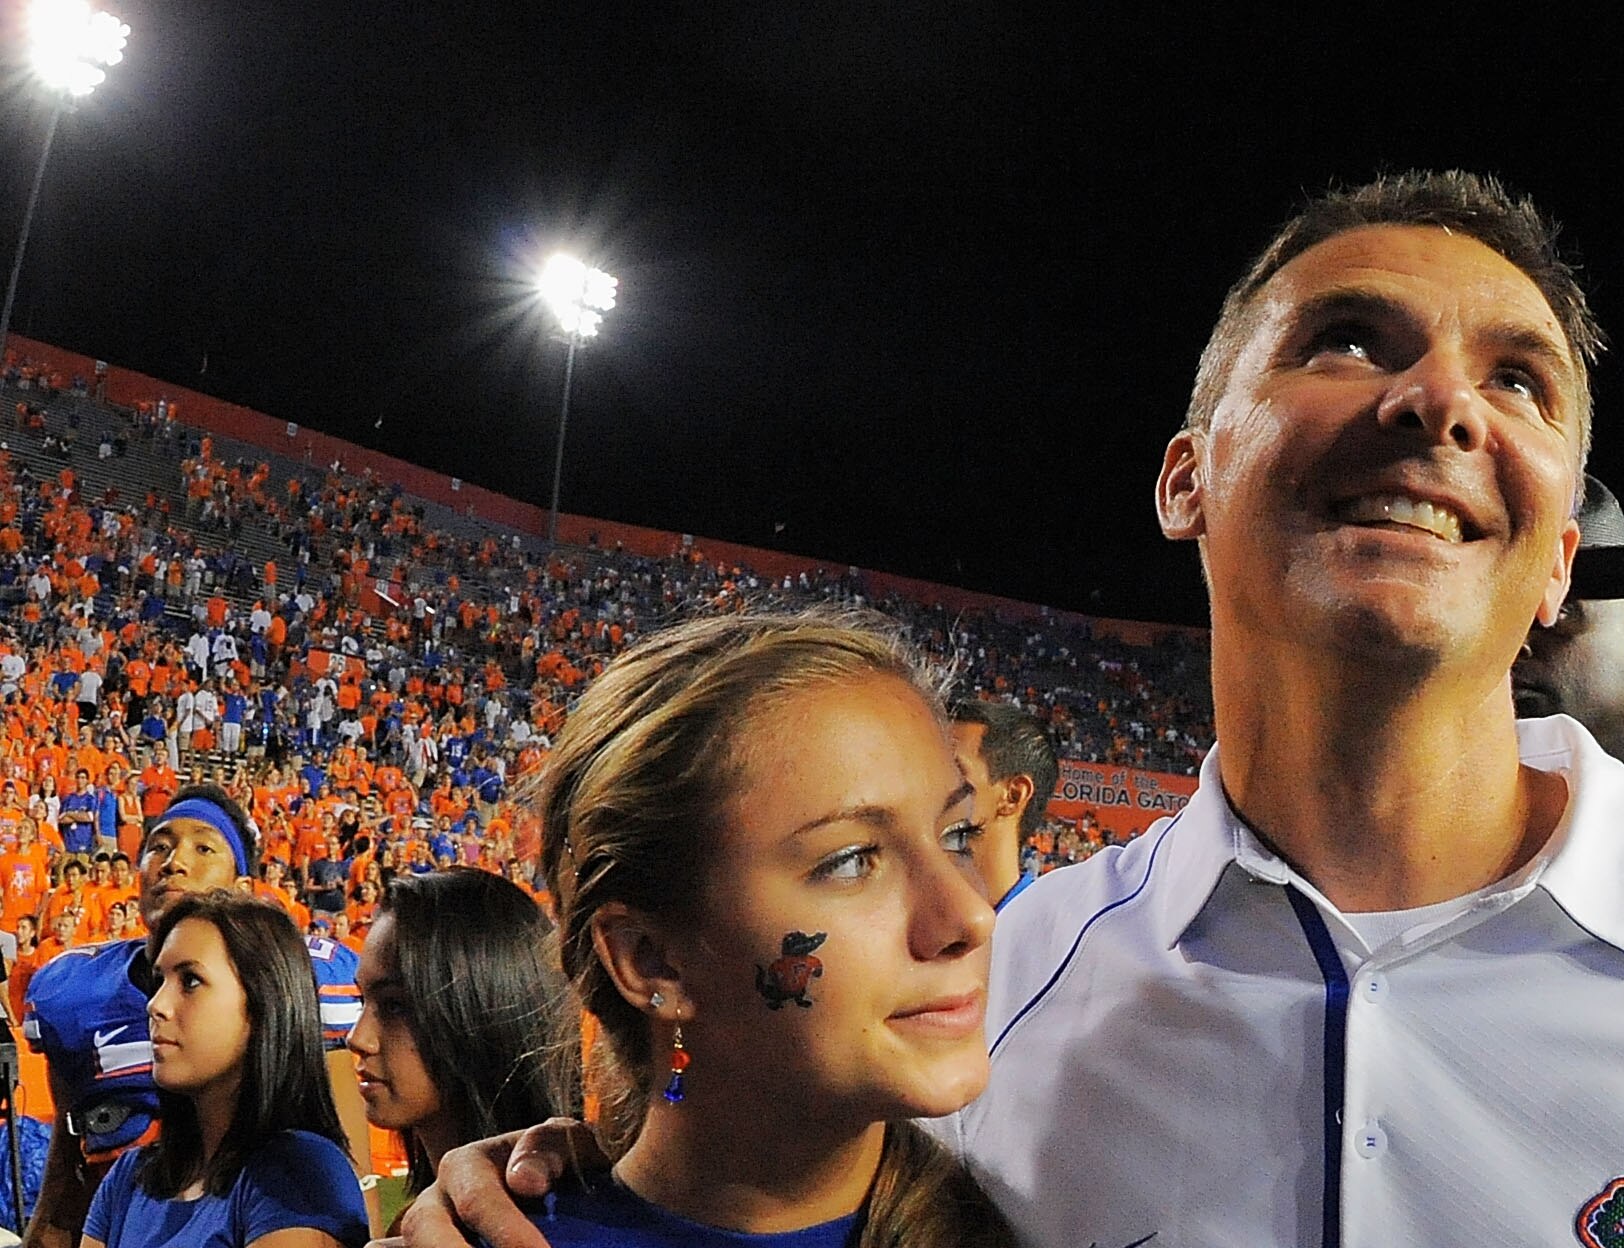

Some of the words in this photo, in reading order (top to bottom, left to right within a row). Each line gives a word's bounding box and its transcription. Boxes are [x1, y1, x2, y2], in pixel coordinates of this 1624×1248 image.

[1062, 764, 1104, 783] Home
[1112, 770, 1126, 785] of
[1134, 775, 1158, 790] the
[1054, 782, 1131, 806] ORIDA
